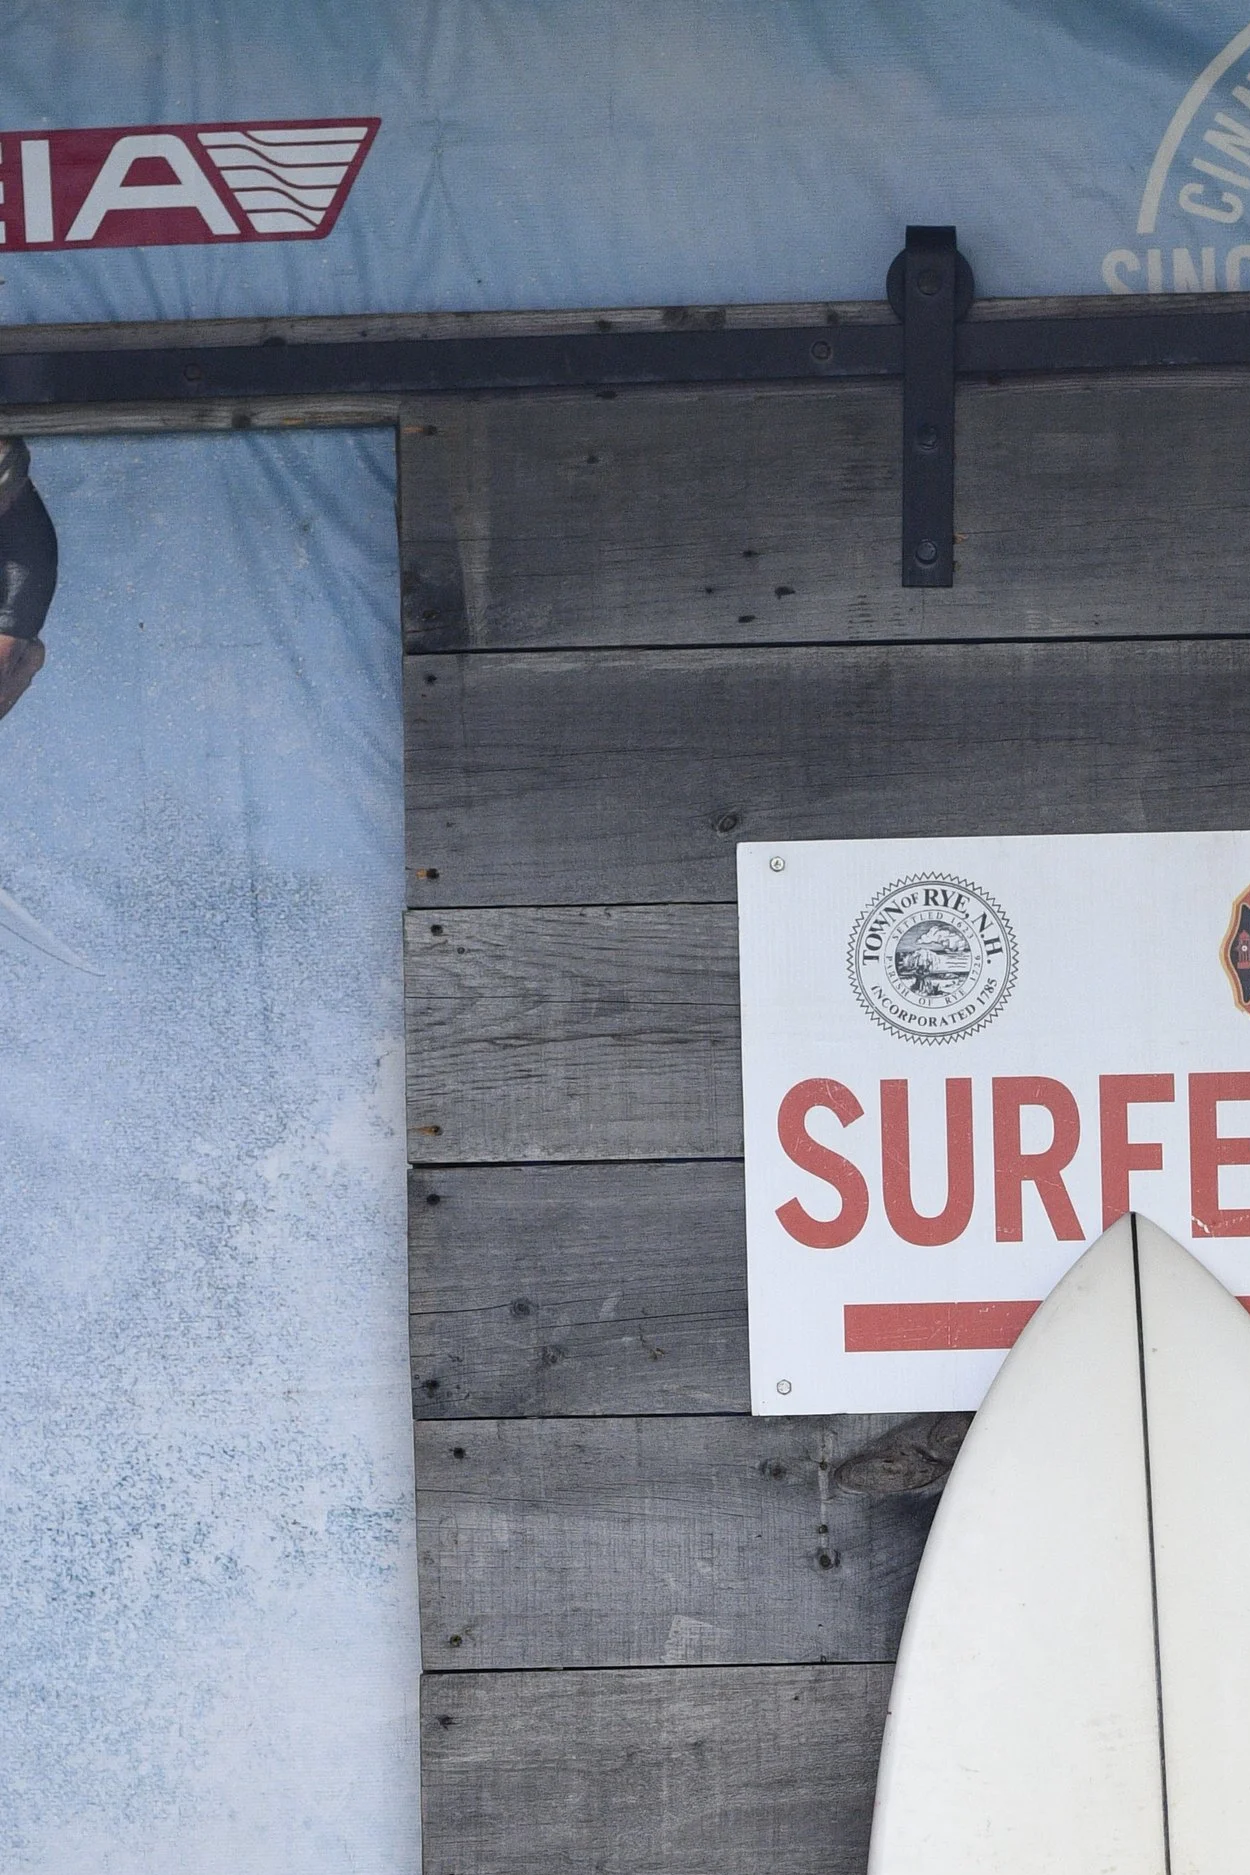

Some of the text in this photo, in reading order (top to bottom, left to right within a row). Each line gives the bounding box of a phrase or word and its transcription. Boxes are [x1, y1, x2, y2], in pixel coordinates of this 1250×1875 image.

[0, 134, 242, 245] IA
[862, 888, 1004, 967] TOWN OF RYE, N.H.
[892, 911, 975, 941] SETTLED 1623
[870, 977, 999, 1028] INCORPORATED 1785
[885, 954, 982, 1008] PARISH OF RYE 1726
